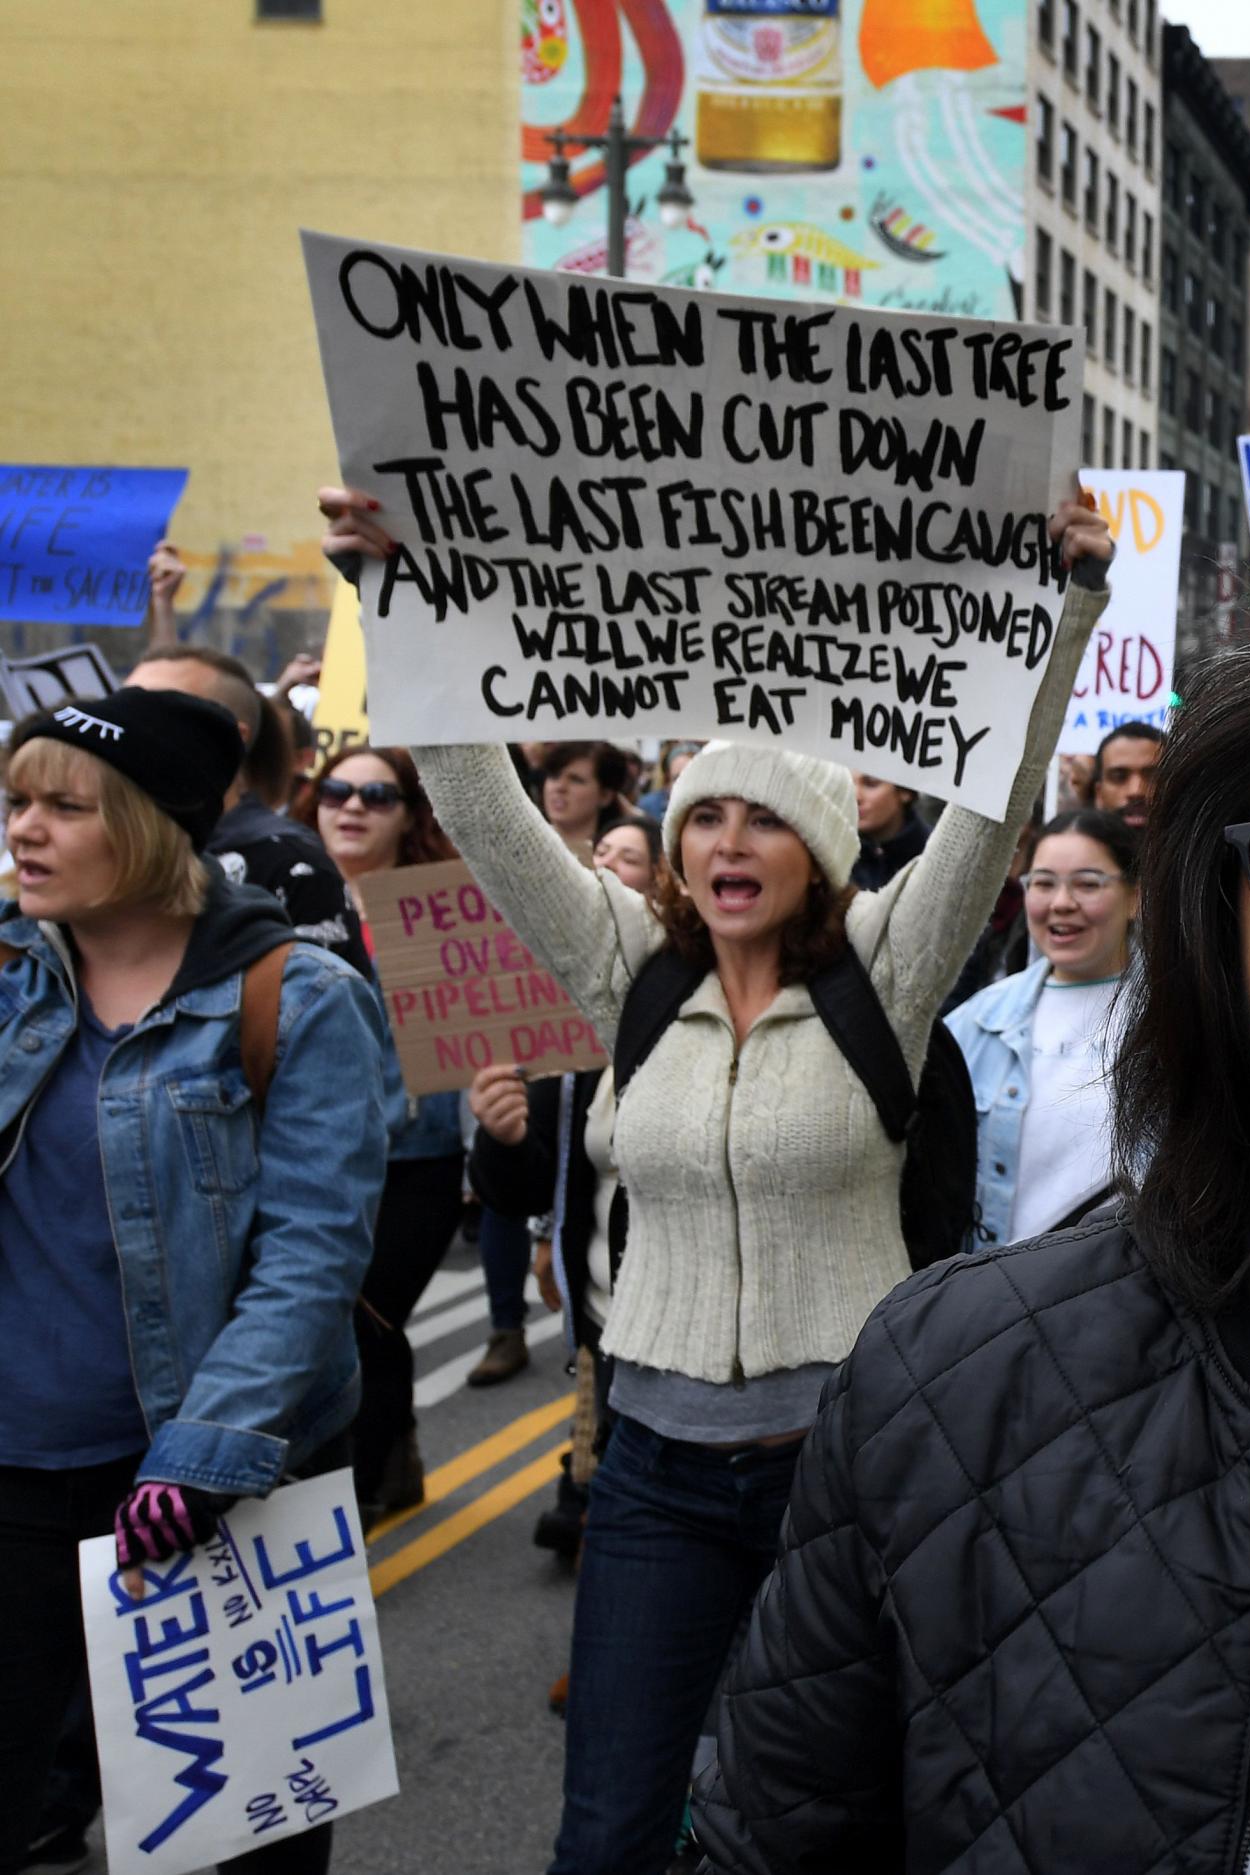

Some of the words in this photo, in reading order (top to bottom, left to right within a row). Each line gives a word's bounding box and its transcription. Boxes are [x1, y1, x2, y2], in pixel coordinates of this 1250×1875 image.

[338, 249, 519, 352] ONLY
[523, 276, 704, 369] WHEN
[716, 308, 836, 385] THE
[846, 322, 958, 399] LAST
[963, 331, 1073, 412] TREE
[416, 360, 561, 458] HAS
[565, 375, 703, 463] BEEN
[722, 393, 829, 468] CUT
[839, 407, 986, 493] DOWN
[373, 457, 510, 545] THE
[510, 472, 647, 554] LAST
[656, 479, 786, 559] FISH
[789, 488, 913, 563] BEEN
[377, 541, 499, 624] AND
[490, 557, 585, 609] THE
[596, 564, 712, 616] LAST
[724, 571, 871, 634] STREAM
[878, 579, 1053, 671] POISONED
[512, 610, 645, 670] WILL
[635, 619, 705, 666] WE
[711, 620, 891, 686] REALIZE
[894, 646, 968, 708] WE
[1073, 631, 1164, 700] RED
[480, 665, 690, 721] CANNOT
[713, 677, 807, 735] EAT
[830, 696, 991, 787] MONEY
[1073, 711, 1088, 728] A
[397, 884, 503, 936] PEO
[440, 927, 536, 977] OVE
[391, 968, 571, 1025] PIPELIN
[434, 1031, 494, 1071] NO
[223, 1594, 253, 1628] NO
[253, 1507, 374, 1751] LIFE
[231, 1639, 277, 1695] IS
[108, 1551, 229, 1853] WATER
[246, 1793, 288, 1834] NO
